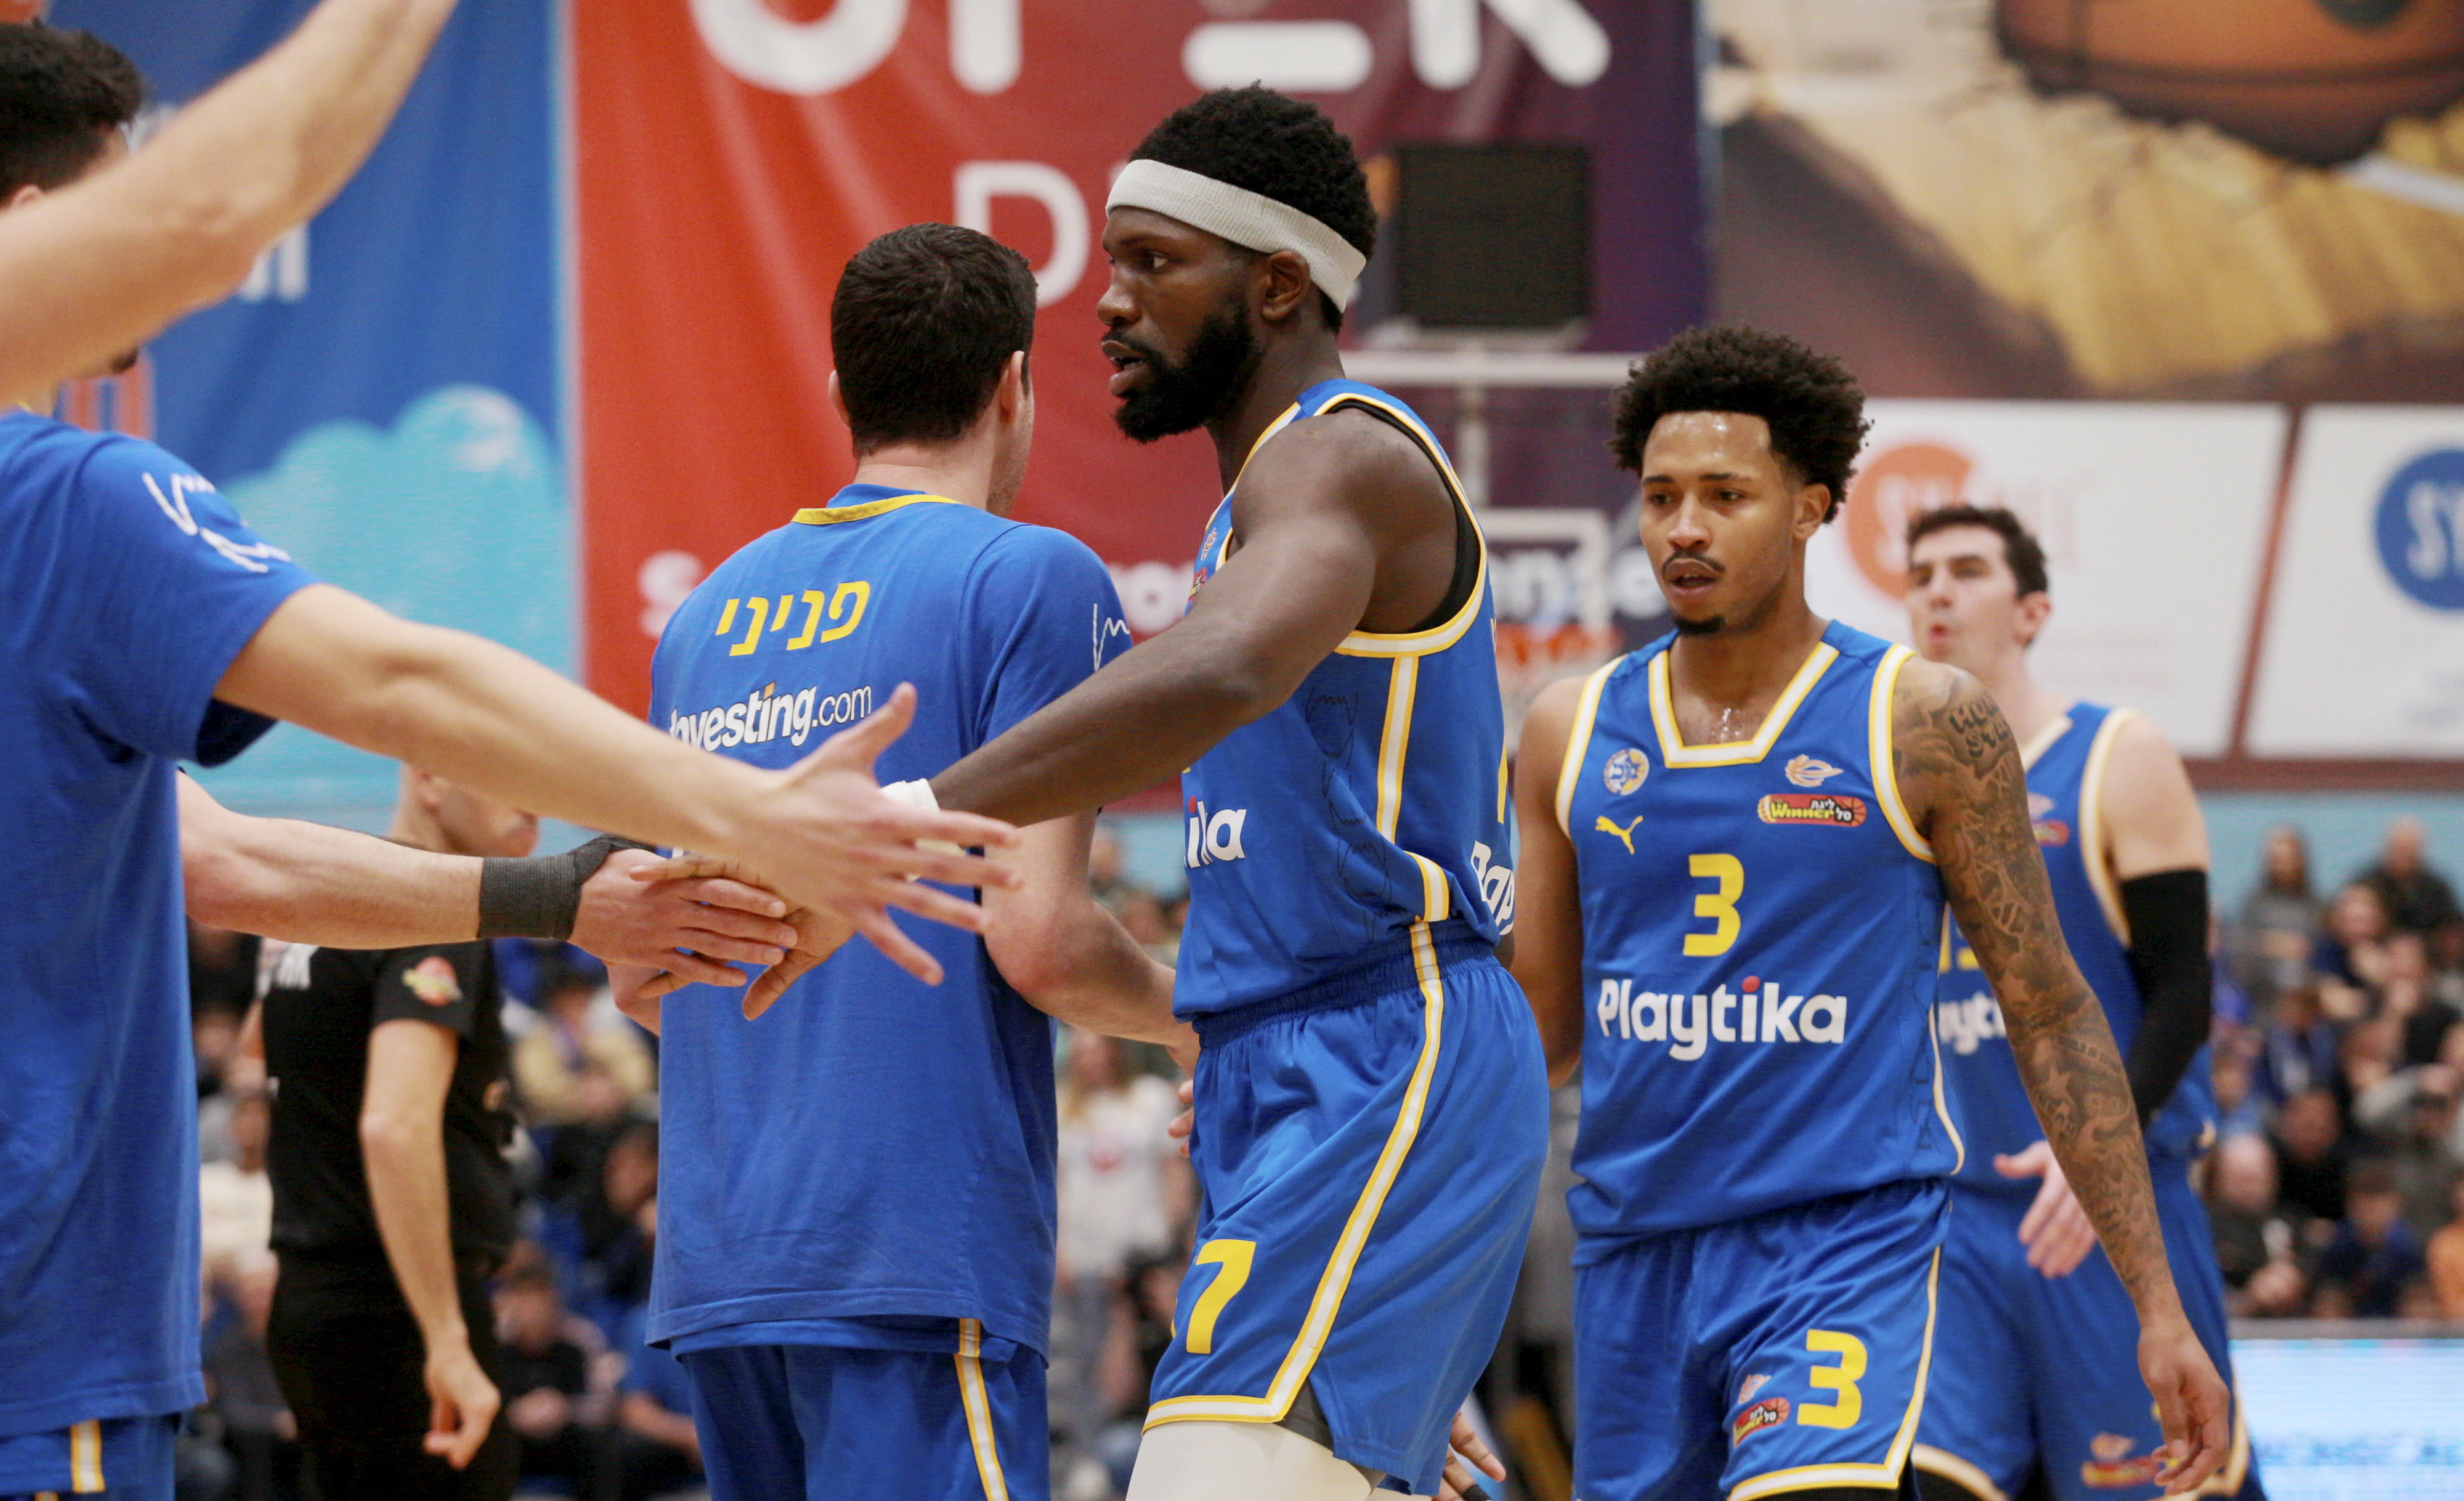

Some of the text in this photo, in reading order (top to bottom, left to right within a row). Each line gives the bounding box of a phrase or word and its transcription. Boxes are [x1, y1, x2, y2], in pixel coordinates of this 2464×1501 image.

[715, 580, 870, 657] פניני
[1770, 802, 1834, 819] Winner
[1836, 807, 1852, 821] סל
[1682, 853, 1745, 957] 3
[1597, 975, 1847, 1061] Playtika
[1797, 1328, 1868, 1429] 3
